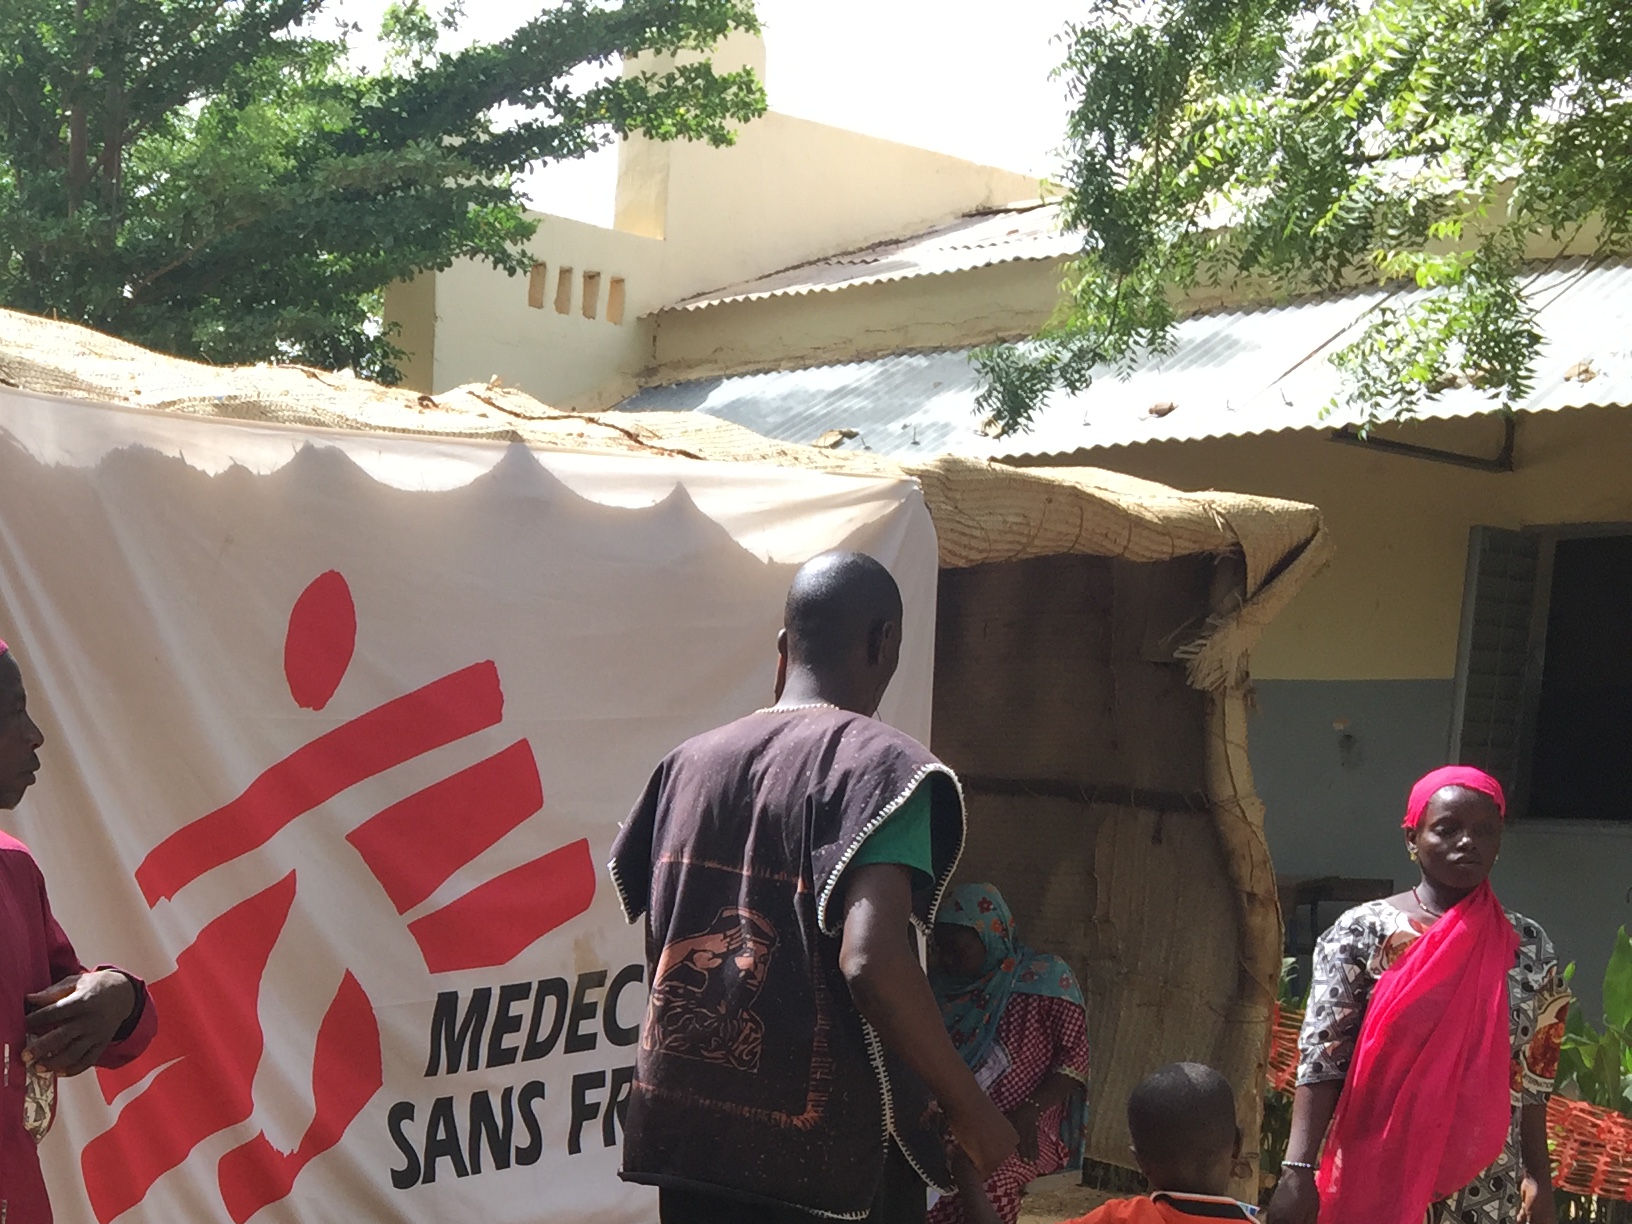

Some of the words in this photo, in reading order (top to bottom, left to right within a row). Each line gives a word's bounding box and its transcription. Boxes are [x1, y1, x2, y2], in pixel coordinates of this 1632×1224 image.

[424, 964, 644, 1077] MEDEC
[387, 1080, 546, 1190] SANS
[568, 1065, 635, 1156] FR
